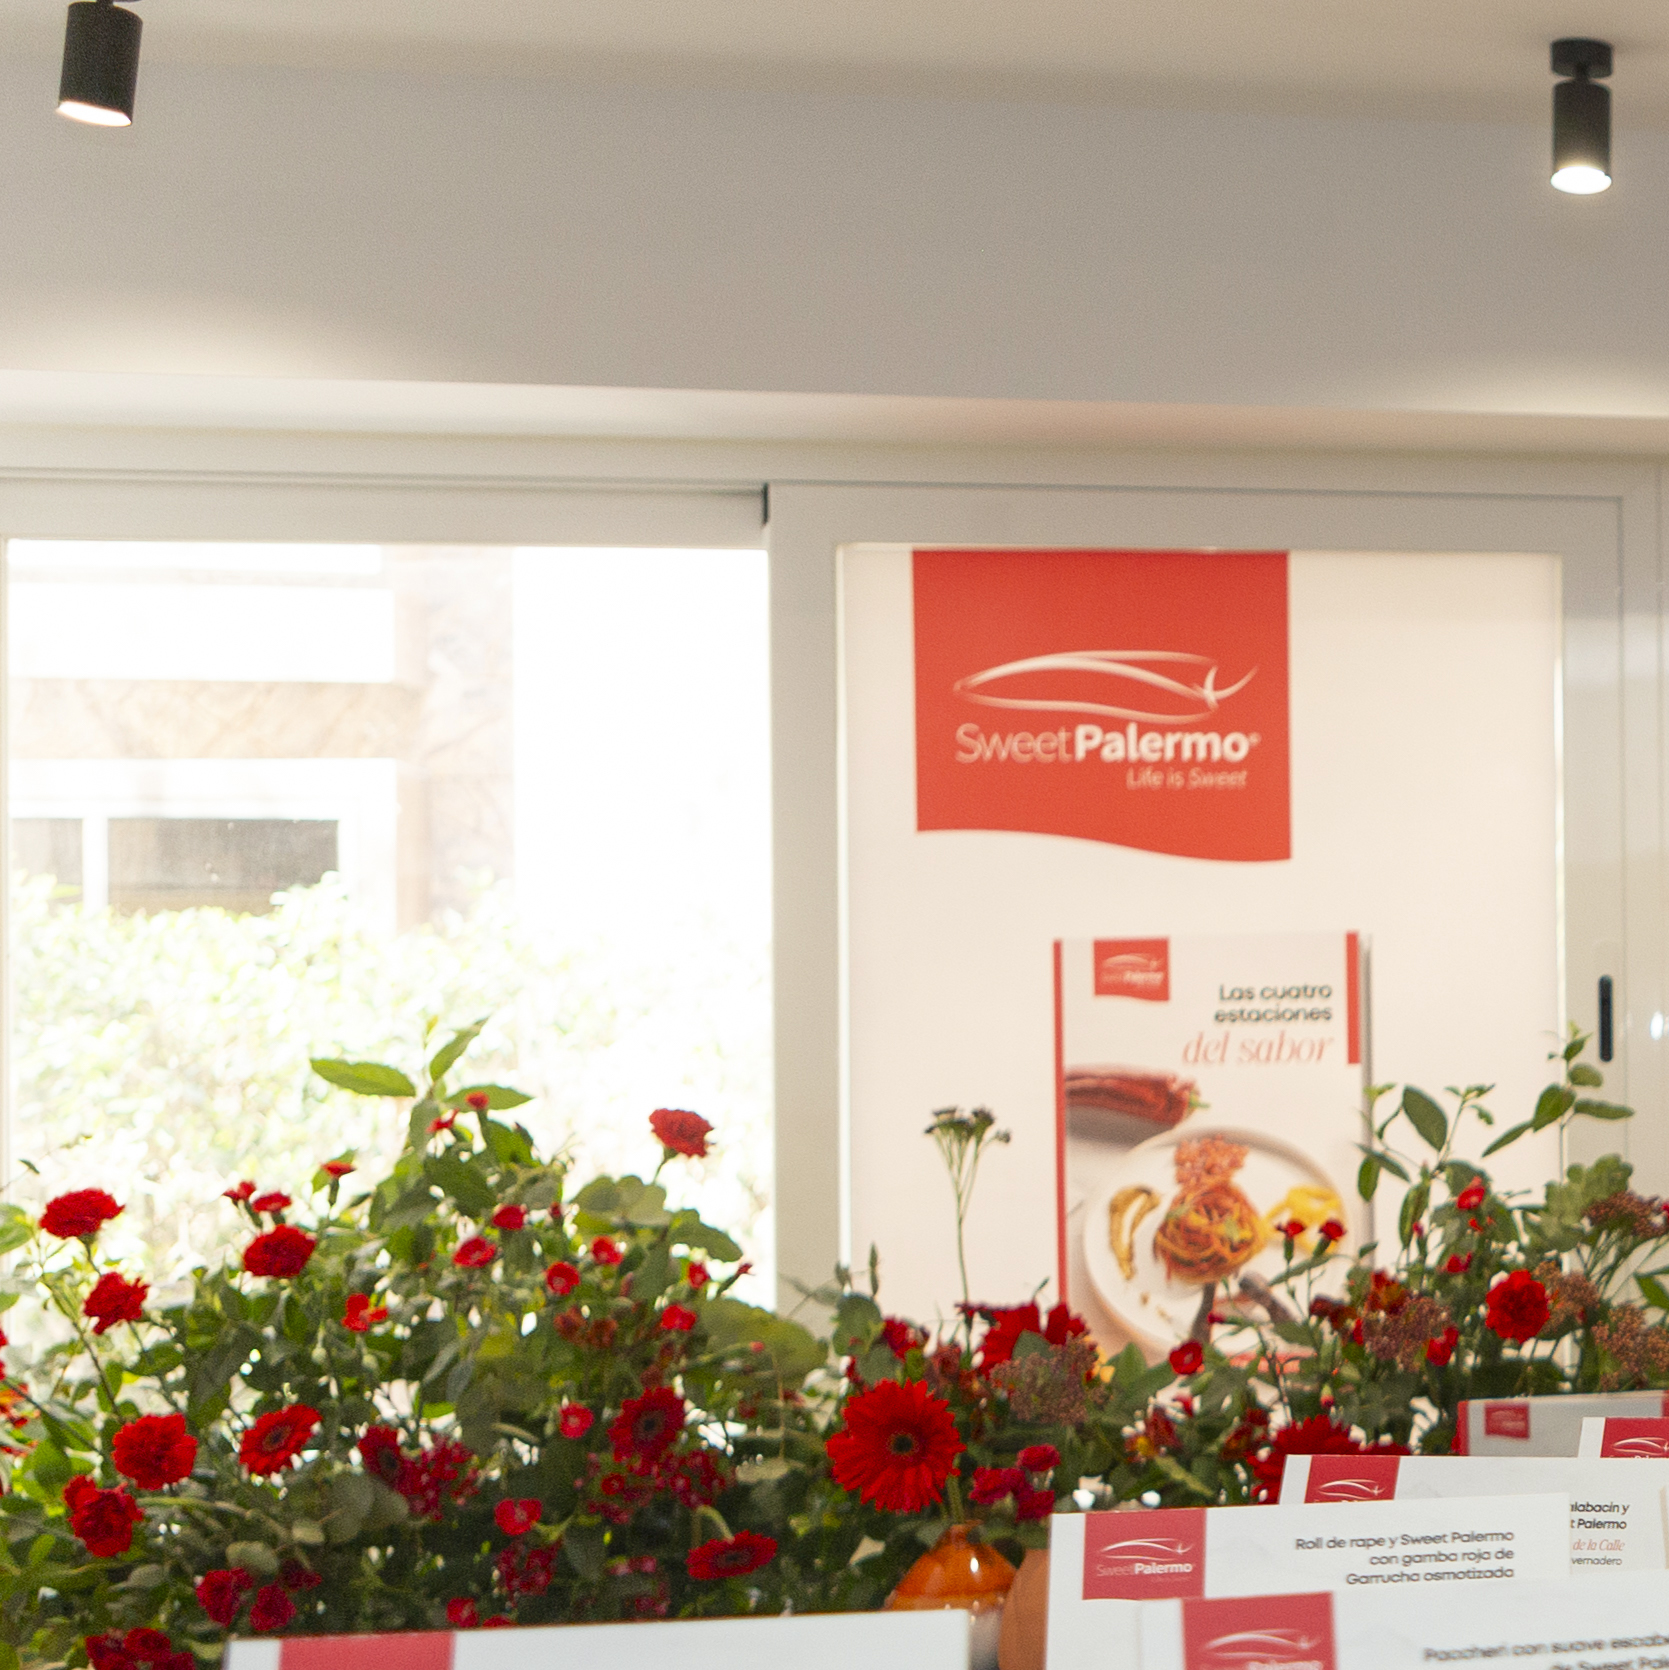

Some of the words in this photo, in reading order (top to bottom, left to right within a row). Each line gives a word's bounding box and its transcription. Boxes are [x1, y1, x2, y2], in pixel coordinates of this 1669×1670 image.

[1126, 767, 1164, 790] Life
[1166, 767, 1185, 790] is
[1187, 767, 1248, 790] Sweet
[1219, 984, 1255, 1001] Las
[1260, 983, 1333, 1001] cuatro
[1214, 1003, 1333, 1022] estaciones
[1182, 1030, 1230, 1064] del
[1239, 1030, 1334, 1064] sabor
[1621, 1504, 1630, 1515] y
[1577, 1518, 1627, 1529] Palermo
[1296, 1537, 1324, 1550] Roll
[1326, 1536, 1346, 1549] de
[1349, 1537, 1386, 1551] rape
[1388, 1538, 1399, 1550] y
[1400, 1533, 1448, 1546] Sweet
[1451, 1530, 1515, 1544] Palermo
[1572, 1539, 1586, 1551] de
[1599, 1539, 1625, 1551] Calle
[1369, 1553, 1399, 1566] con
[1402, 1550, 1458, 1567] gamba
[1461, 1548, 1491, 1563] roja
[1494, 1547, 1515, 1560] de
[1346, 1569, 1420, 1586] Garrucha
[1423, 1566, 1515, 1583] osmotizada
